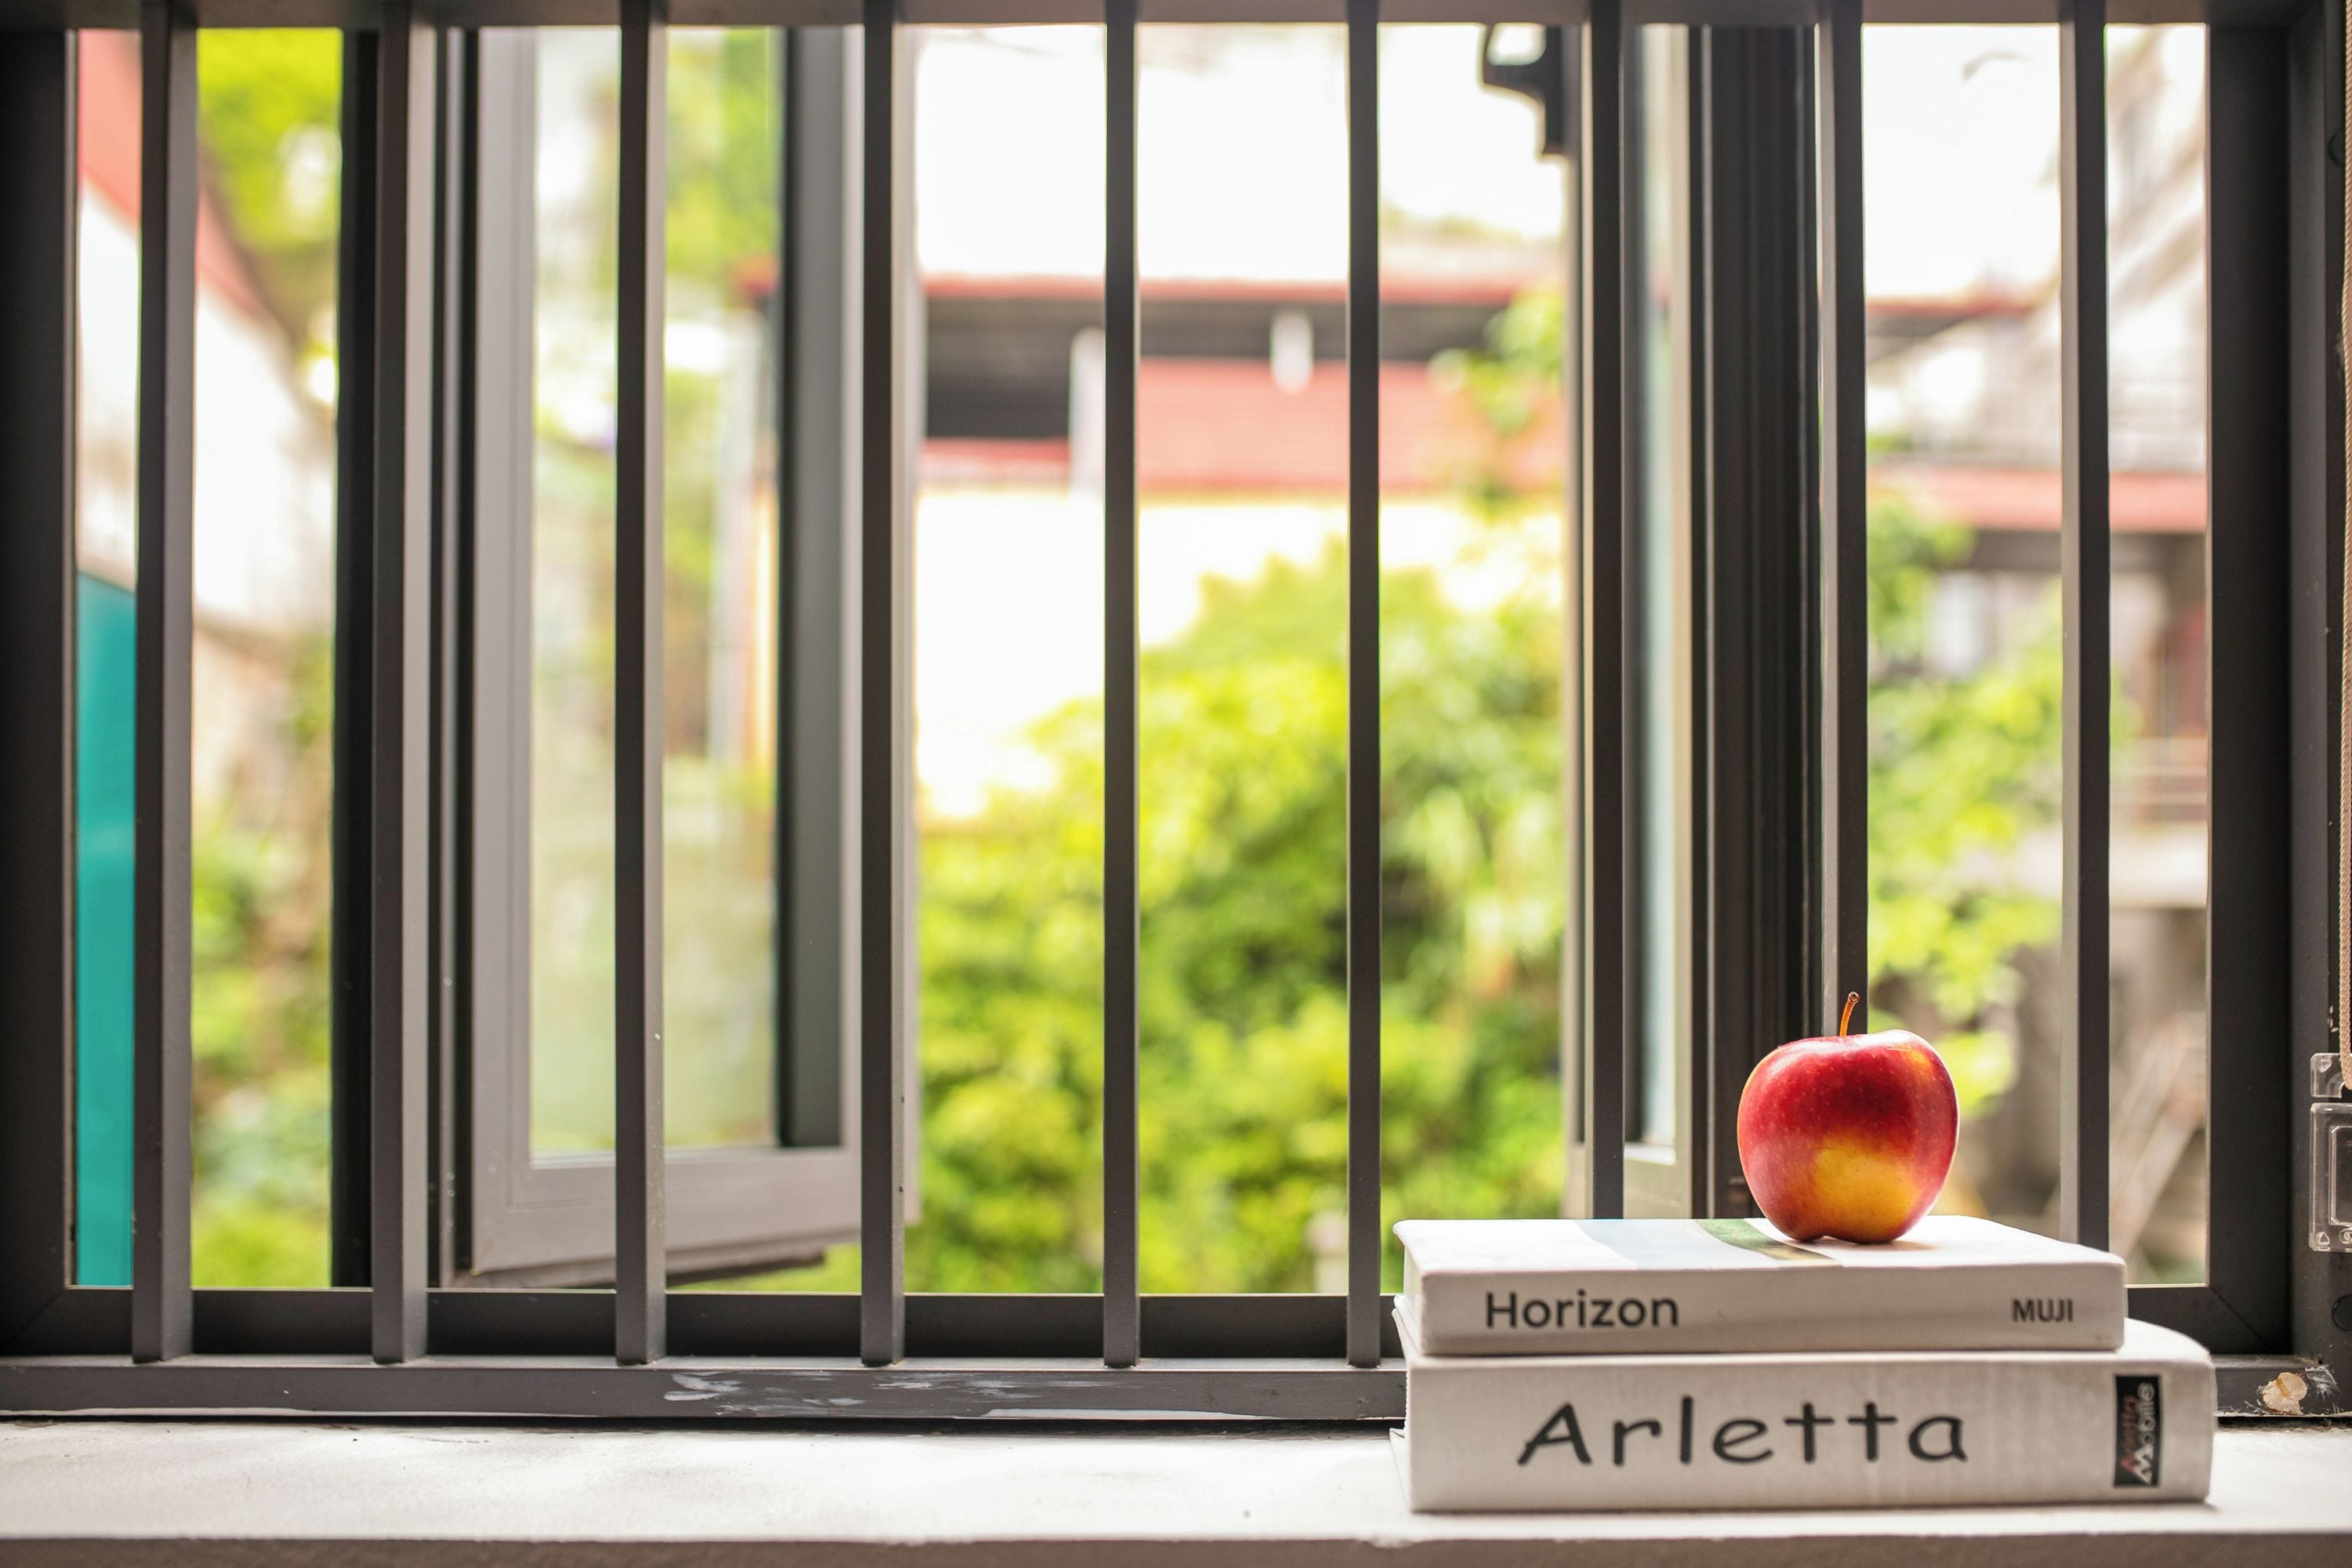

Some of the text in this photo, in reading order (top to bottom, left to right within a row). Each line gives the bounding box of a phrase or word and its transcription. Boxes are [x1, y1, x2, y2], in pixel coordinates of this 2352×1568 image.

[1485, 1288, 1680, 1330] Horizon
[2011, 1298, 2075, 1324] MUJI
[1517, 1395, 1969, 1466] Arletta
